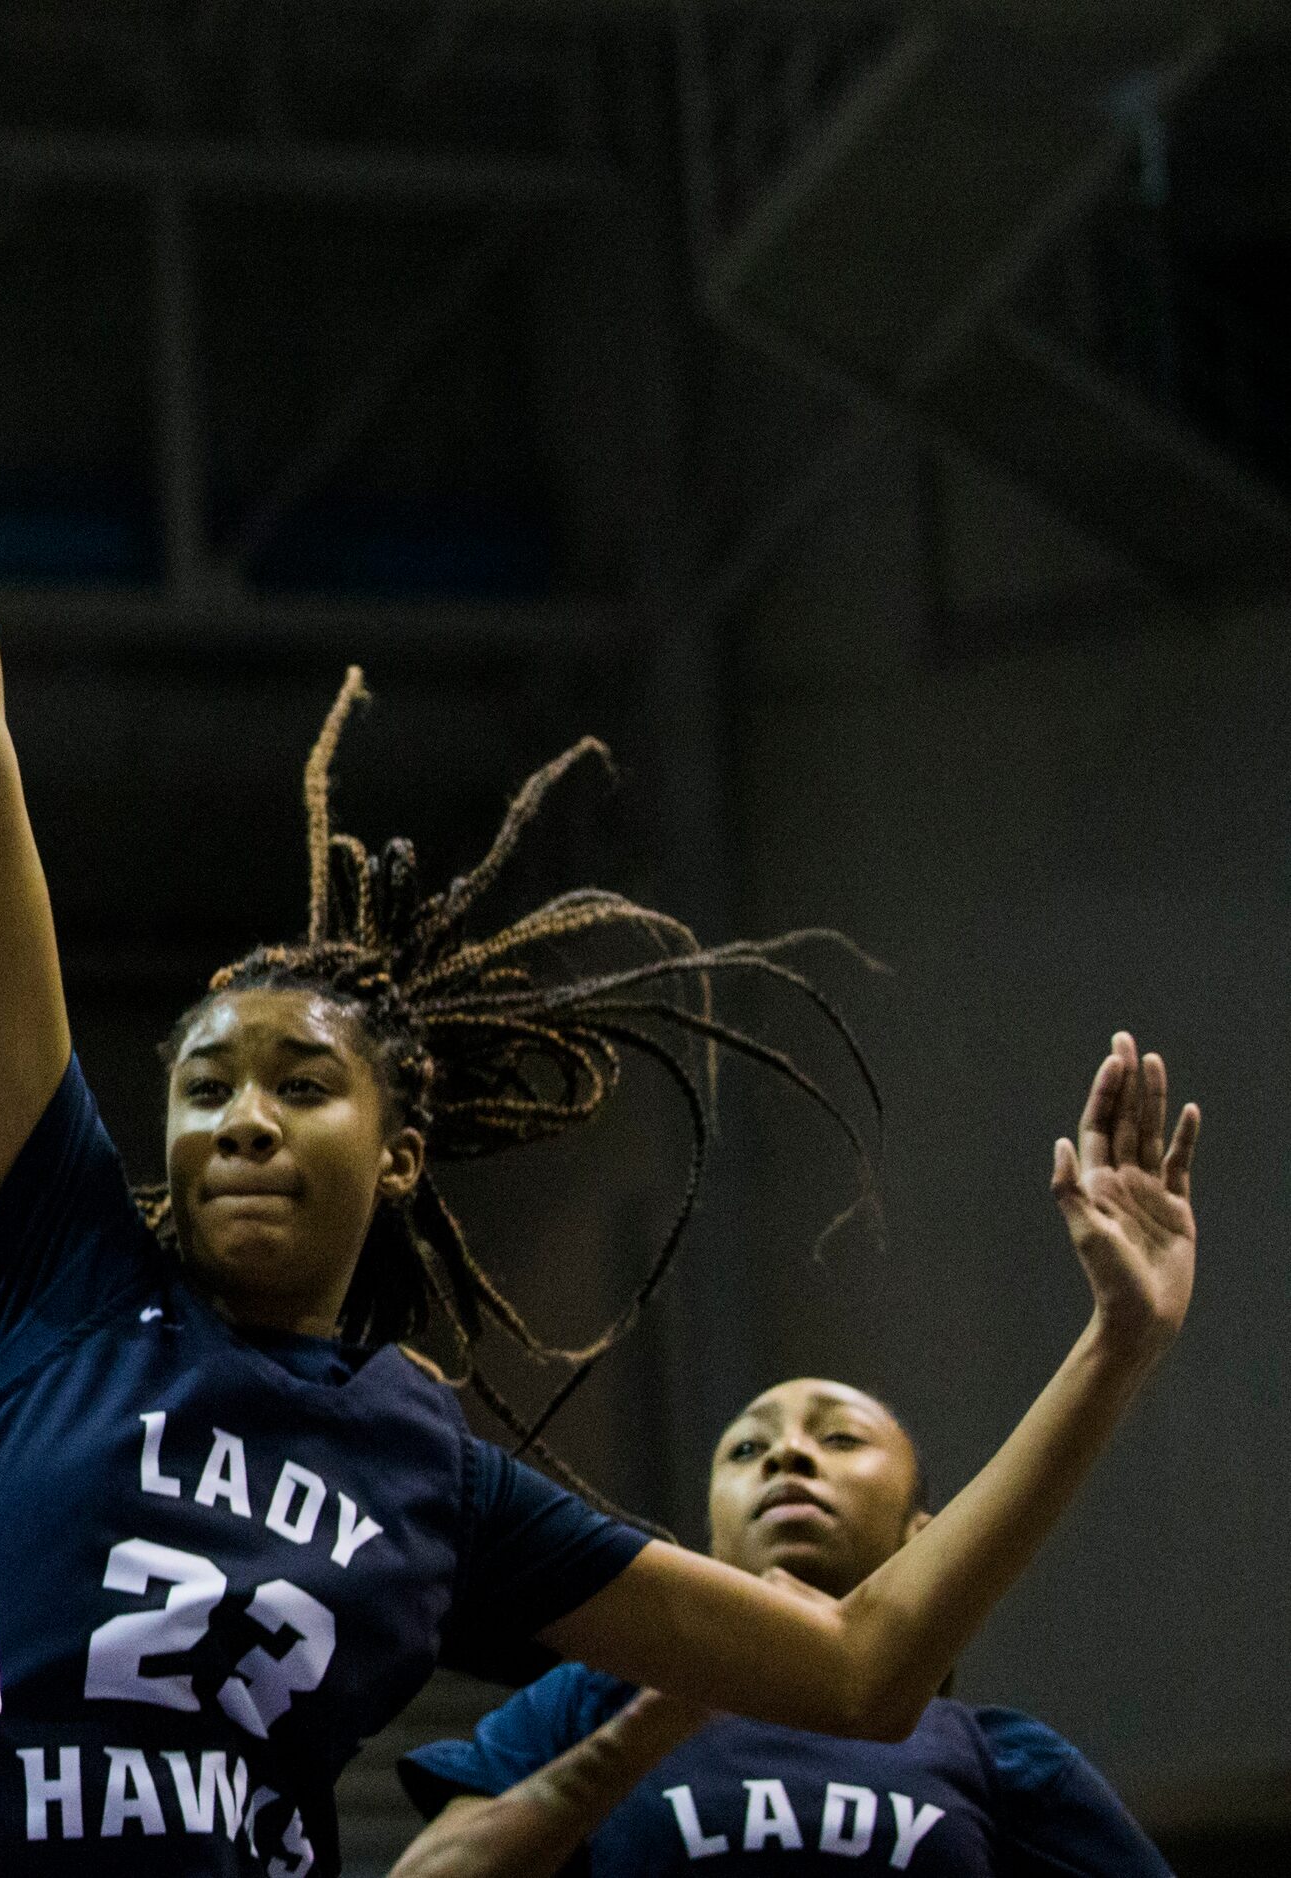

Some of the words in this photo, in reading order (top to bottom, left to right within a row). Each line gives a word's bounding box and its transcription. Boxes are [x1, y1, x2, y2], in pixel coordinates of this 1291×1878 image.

[139, 1410, 384, 1568] LADY
[84, 1537, 336, 1739] 23
[663, 1779, 946, 1871] LADY
